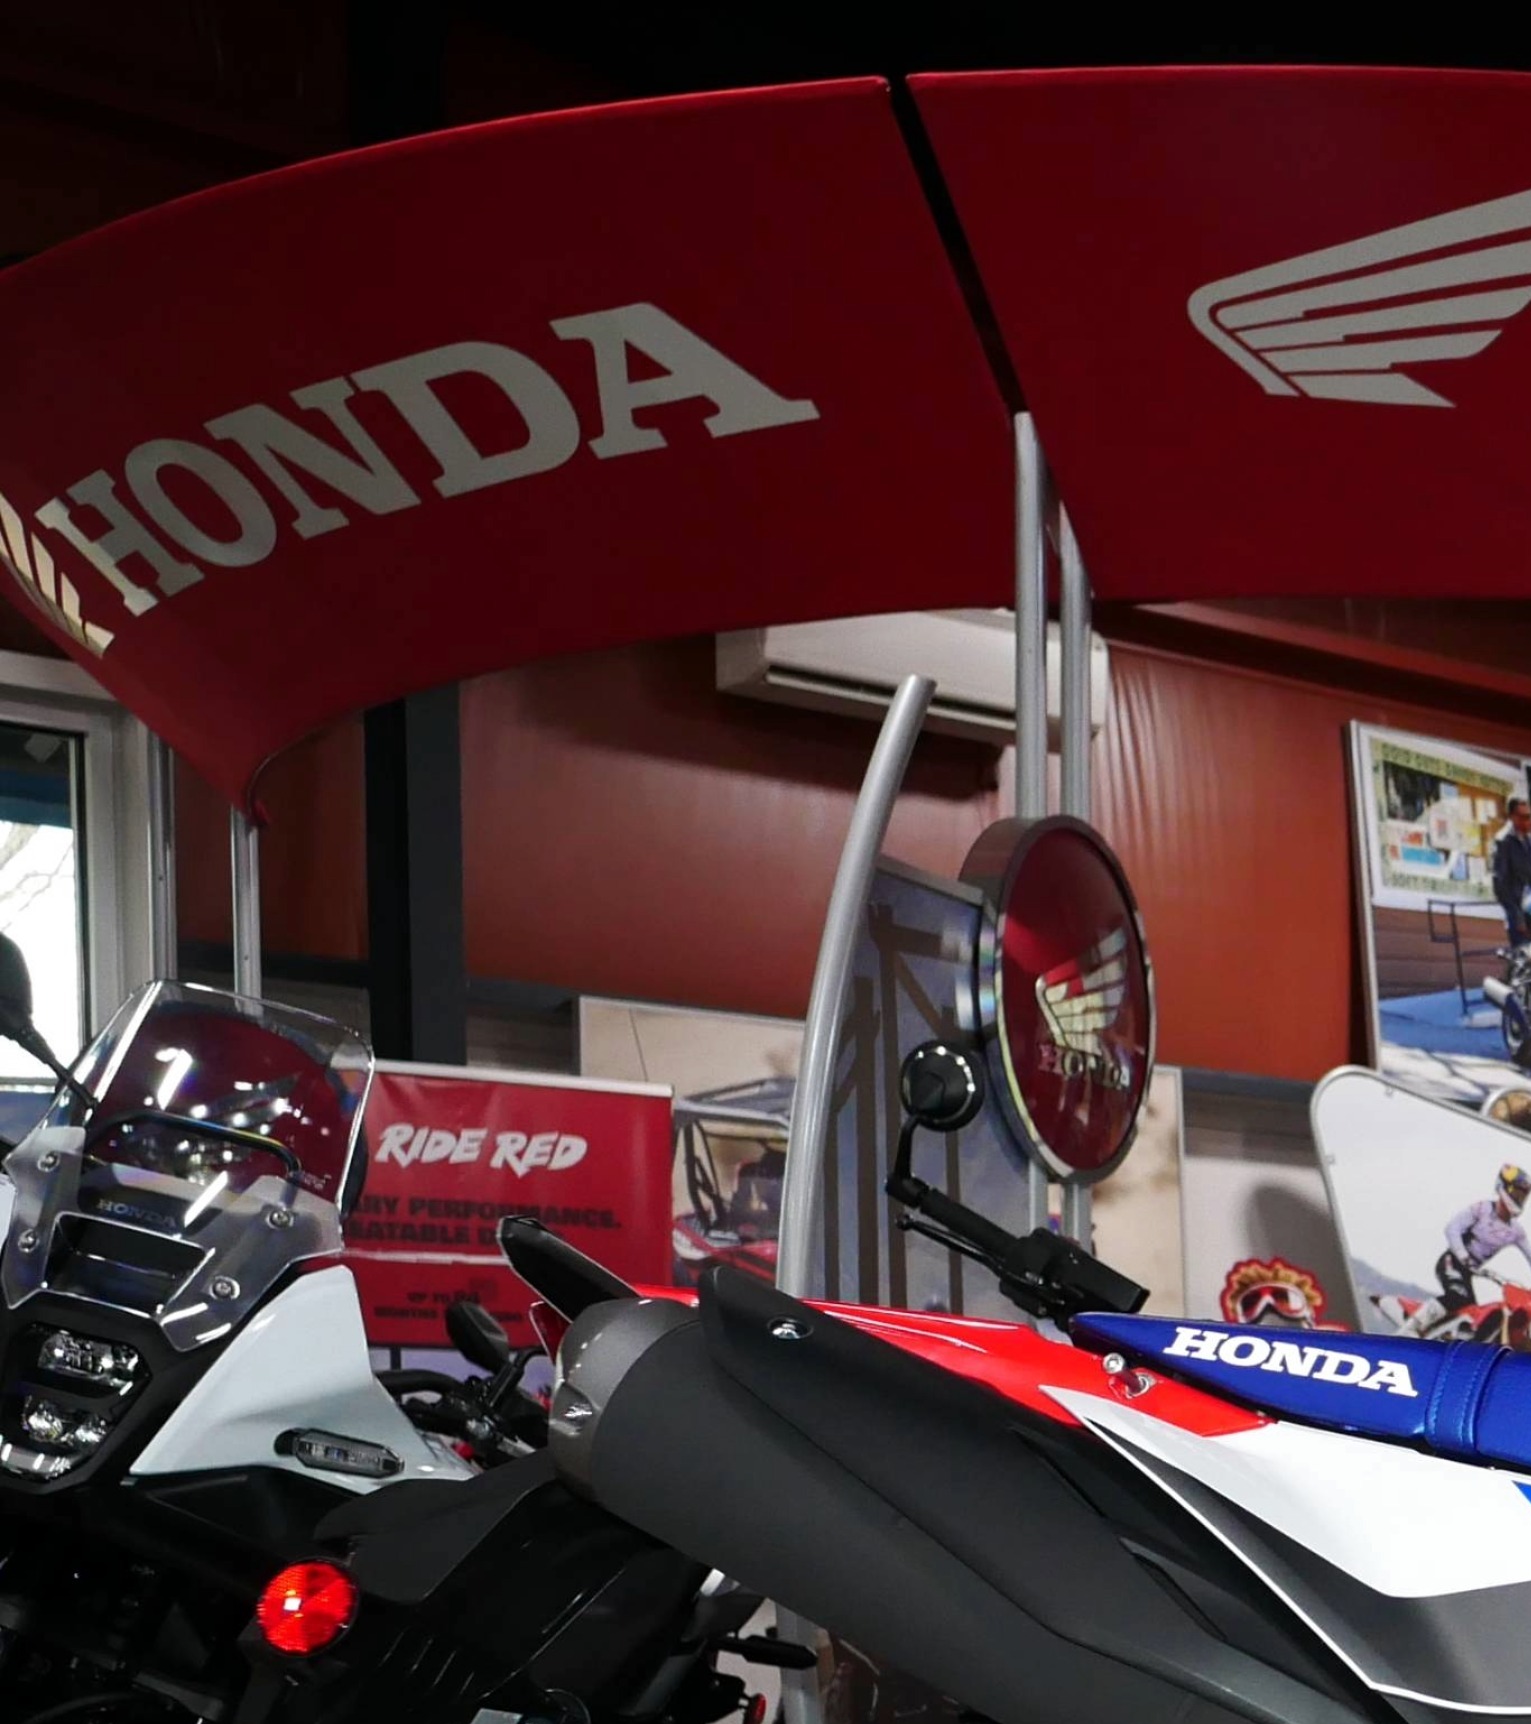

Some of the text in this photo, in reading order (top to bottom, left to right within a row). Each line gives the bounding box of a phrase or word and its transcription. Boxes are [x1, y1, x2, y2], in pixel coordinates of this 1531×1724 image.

[35, 302, 821, 616] HONDA
[375, 1122, 588, 1178] RIDE RED
[98, 1198, 177, 1228] HONDA
[1163, 1326, 1418, 1397] HONDA
